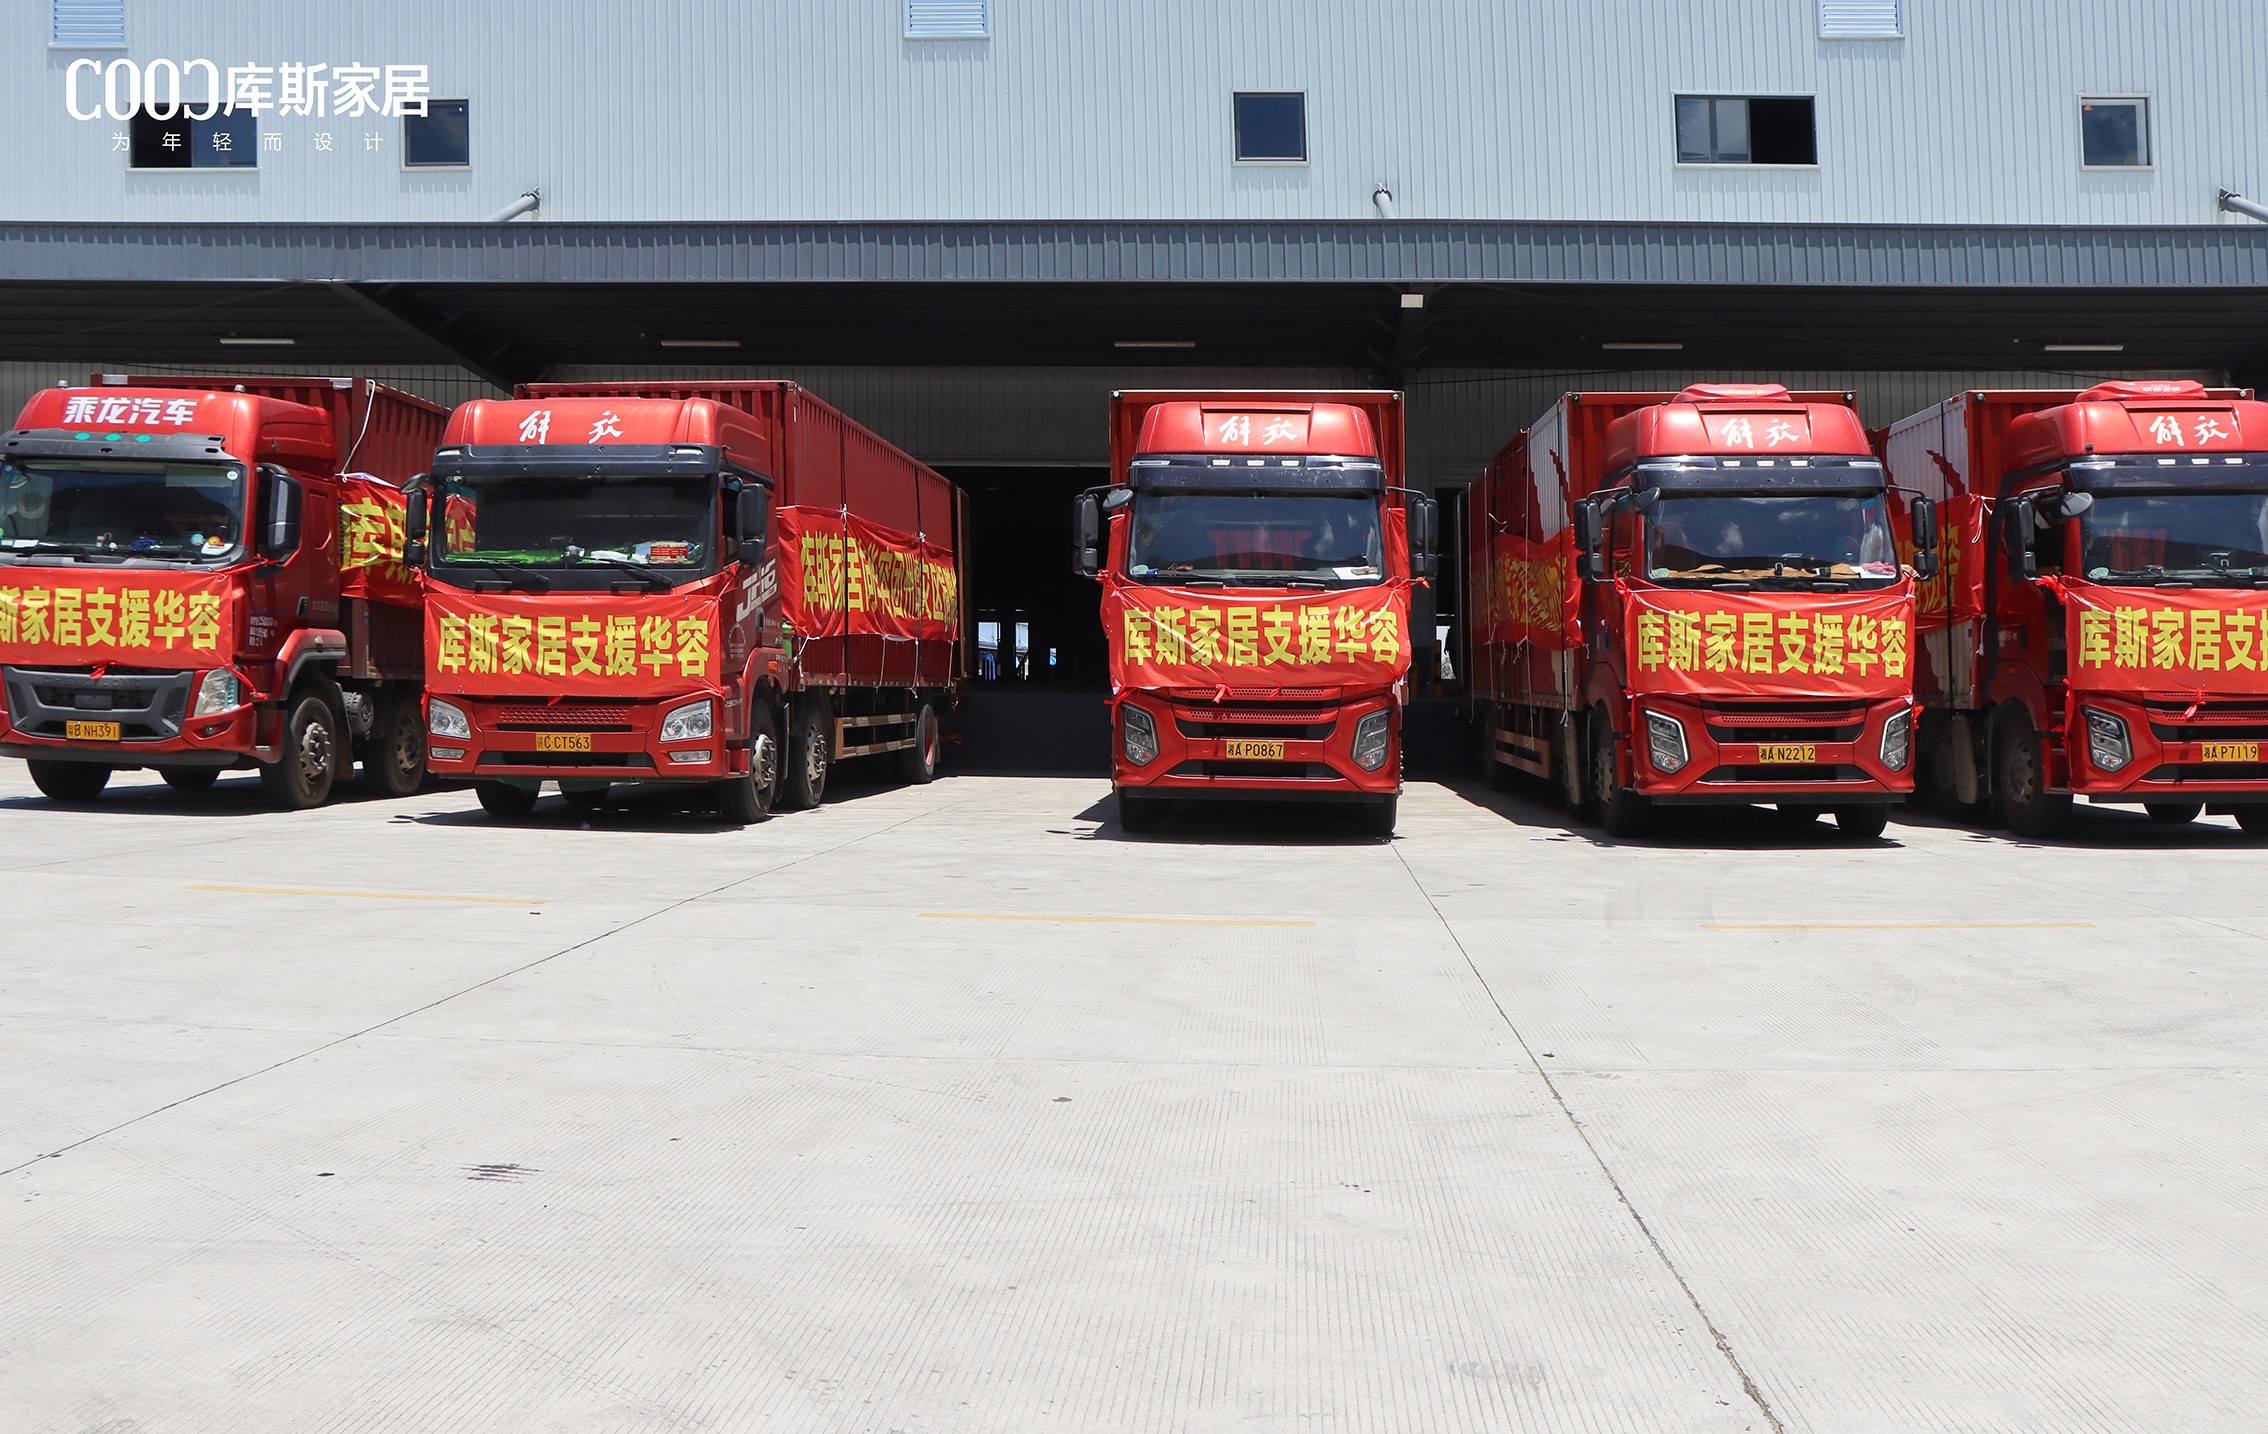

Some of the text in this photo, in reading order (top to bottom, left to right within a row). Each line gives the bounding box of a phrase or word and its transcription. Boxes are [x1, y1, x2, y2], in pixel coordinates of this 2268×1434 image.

[63, 396, 197, 426] 乘龙汽车
[519, 410, 624, 445] 解放
[1218, 415, 1298, 446] 解放
[1720, 417, 1800, 448] 解放
[2149, 415, 2229, 446] 解放
[436, 613, 709, 677] 库斯家居支援华容
[1124, 604, 1400, 667] 库斯家居支援华容
[1637, 610, 1907, 677] 库斯家居支援华容
[2078, 606, 2268, 671] 库斯家居支
